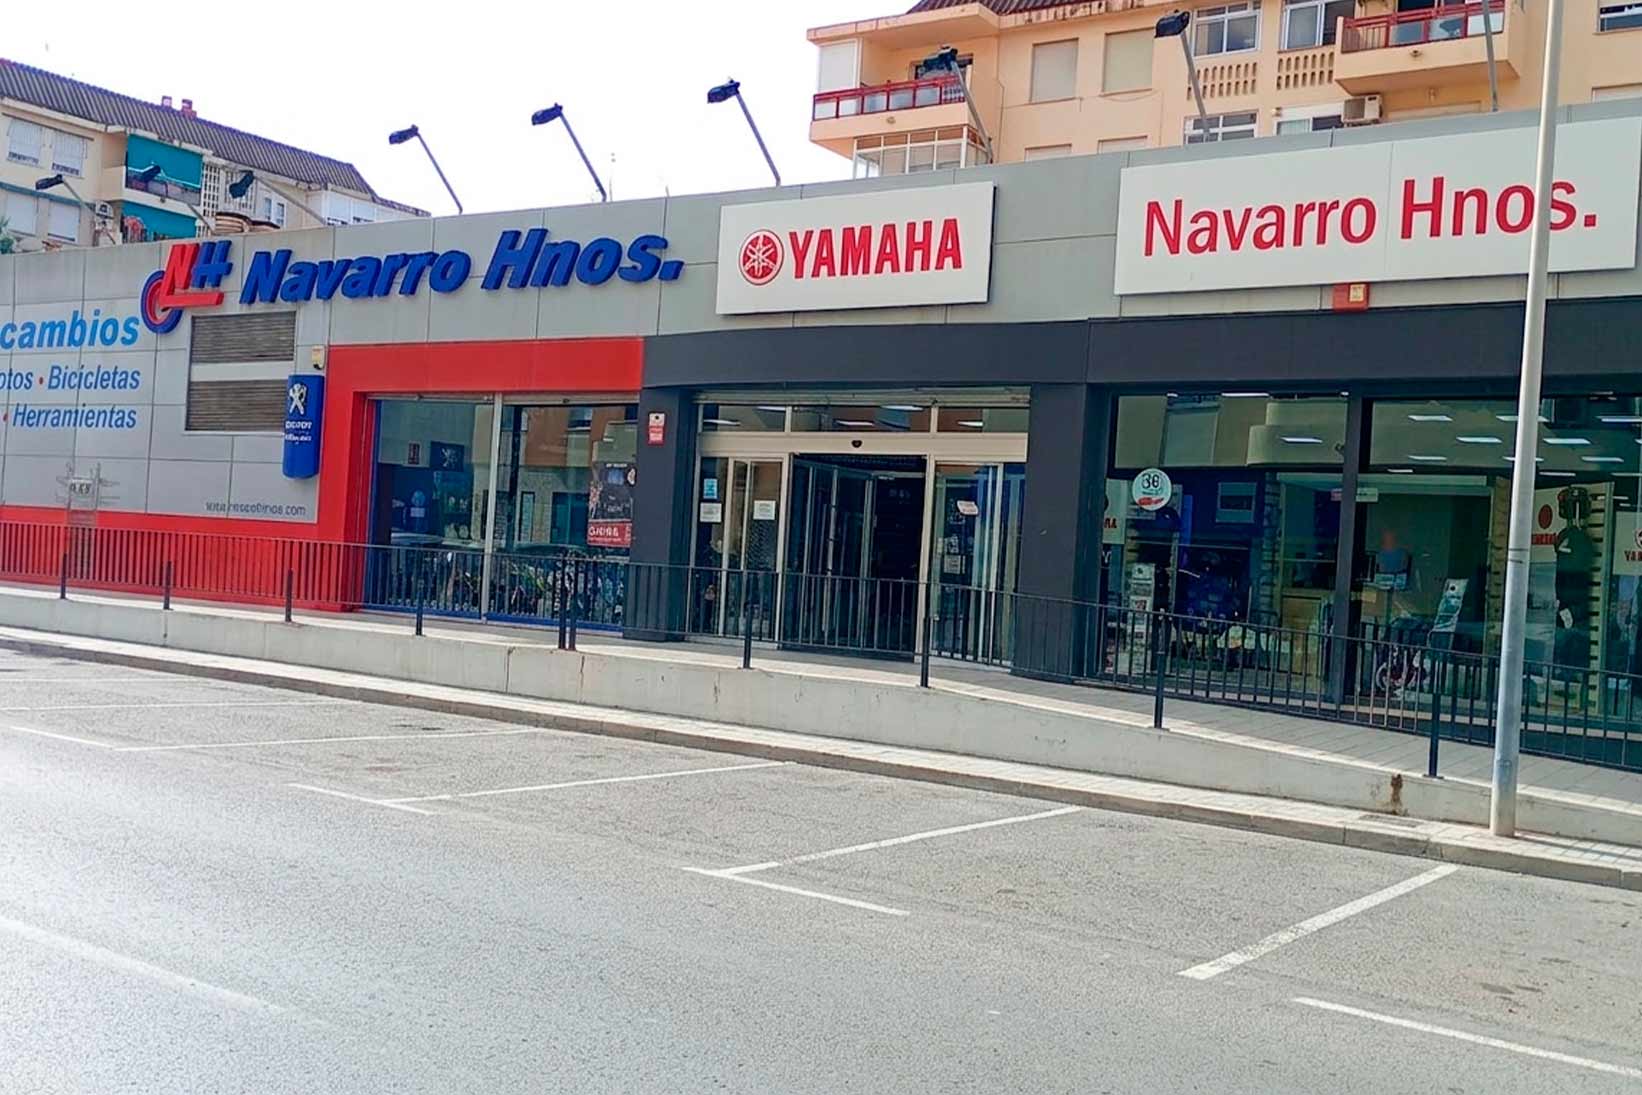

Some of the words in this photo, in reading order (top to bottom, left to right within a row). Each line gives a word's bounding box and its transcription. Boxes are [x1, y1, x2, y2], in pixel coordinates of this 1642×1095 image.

[1143, 195, 1377, 257] Navarro
[1400, 176, 1597, 240] Hnos.
[239, 249, 471, 305] Navarro
[481, 228, 685, 290] Hnos.
[789, 218, 963, 280] YAMAHA
[0, 309, 140, 349] cambios
[48, 365, 141, 390] Bicicletas
[12, 403, 137, 429] Herramientas
